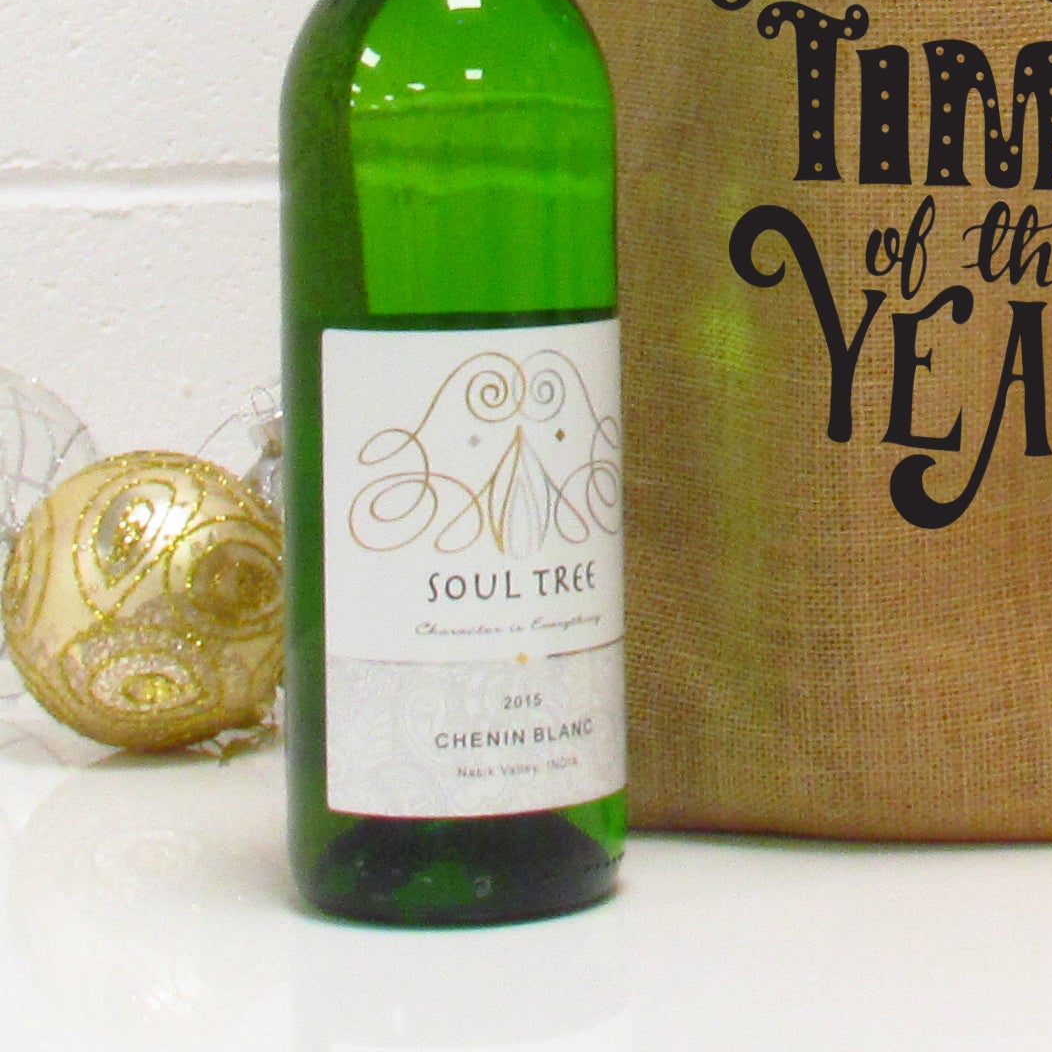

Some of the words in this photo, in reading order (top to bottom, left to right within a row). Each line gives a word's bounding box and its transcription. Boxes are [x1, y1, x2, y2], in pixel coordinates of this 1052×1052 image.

[866, 195, 935, 300] of
[428, 570, 521, 603] SOUL
[533, 560, 596, 596] TREE
[503, 693, 543, 710] 2015
[434, 728, 526, 749] CHENIN
[533, 718, 594, 744] BLANC
